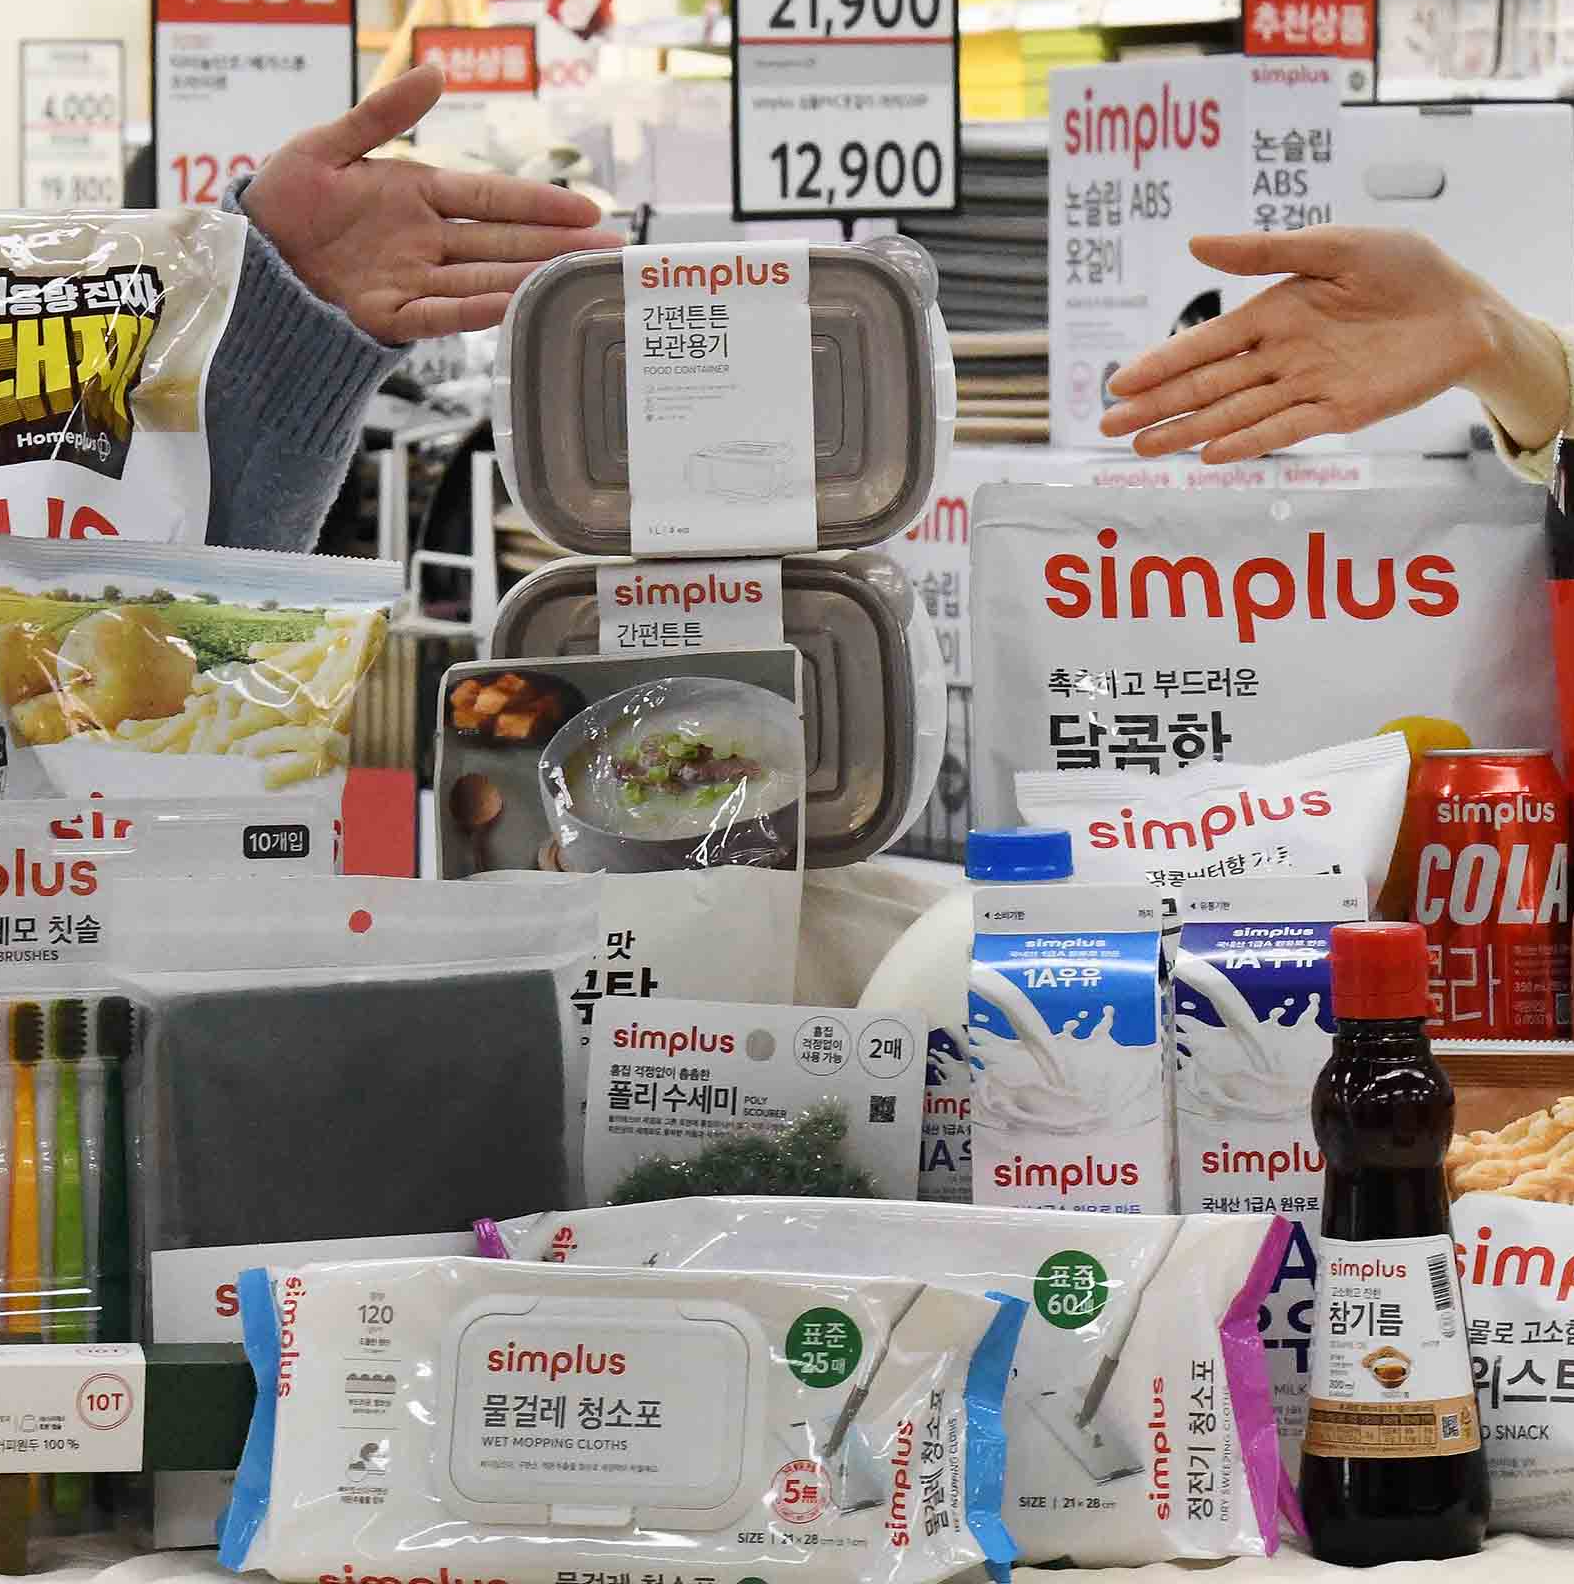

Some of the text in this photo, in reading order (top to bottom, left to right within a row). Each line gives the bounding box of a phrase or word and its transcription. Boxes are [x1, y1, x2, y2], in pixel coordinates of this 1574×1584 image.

[1251, 5, 1367, 46] 추천상품
[1251, 67, 1330, 84] simplus
[1065, 83, 1221, 171] simplus
[771, 141, 942, 205] 12,900
[1253, 170, 1308, 197] ABS
[1066, 180, 1173, 228] 논슬립 ABS
[641, 256, 790, 296] simplus
[643, 304, 729, 331] 간편튼튼
[644, 334, 729, 361] 보관용기
[16, 429, 99, 452] Homeplus
[615, 575, 763, 612] simplus
[1044, 528, 1459, 643] simplus
[617, 621, 703, 649] 간편튼튼
[1153, 668, 1259, 698] 부드러운
[1089, 787, 1332, 851] simplus
[1437, 795, 1555, 828] simplus
[248, 831, 304, 853] 10개입
[1416, 843, 1569, 925] COLA
[49, 914, 101, 945] 칫솔
[1024, 937, 1106, 950] simplus
[1232, 926, 1314, 939] simplus
[1023, 967, 1102, 989] 1A우유
[613, 1022, 735, 1057] simplus
[869, 1037, 903, 1061] 2매
[608, 1080, 738, 1116] 폴리 수세미
[994, 1156, 1140, 1194] simplus
[1201, 1196, 1320, 1213] 국내산 1급A 원유로
[1049, 1265, 1095, 1290] 표준
[1329, 1258, 1407, 1282] simplus
[357, 1304, 394, 1324] 120
[1329, 1302, 1404, 1337] 참기름
[801, 1322, 847, 1348] 표준
[488, 1342, 626, 1381] simplus
[87, 1392, 124, 1412] 10T
[482, 1394, 662, 1430] 물걸레 청소포
[1187, 1359, 1217, 1521] 정전기 청소포
[1496, 1424, 1550, 1440] SNACK
[1148, 1376, 1171, 1521] simplus
[1019, 1496, 1047, 1509] SIZE
[737, 1531, 765, 1544] SIZE
